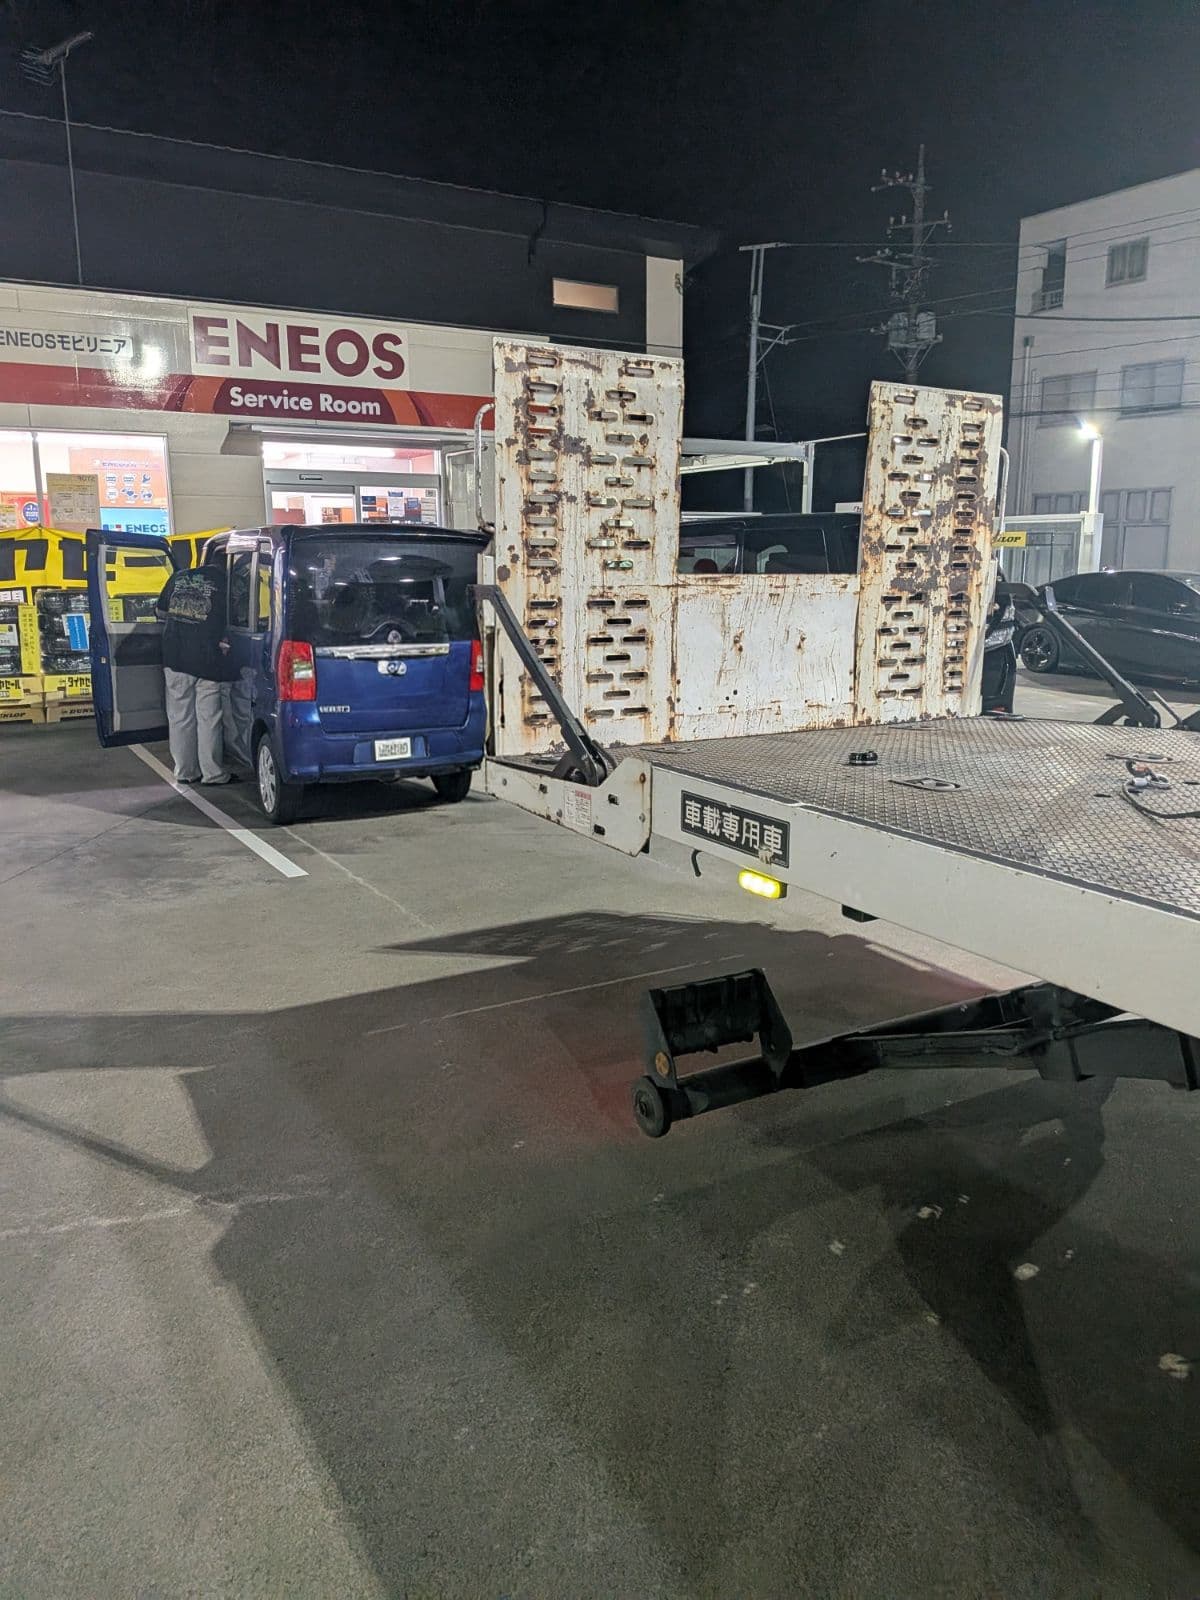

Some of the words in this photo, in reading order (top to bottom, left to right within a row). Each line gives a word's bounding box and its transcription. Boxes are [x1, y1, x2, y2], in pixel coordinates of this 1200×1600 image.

[193, 315, 405, 380] ENEOS
[230, 386, 312, 411] Service
[318, 393, 381, 416] Room
[126, 523, 166, 533] ENEOS
[684, 799, 783, 856] 車載専用車
